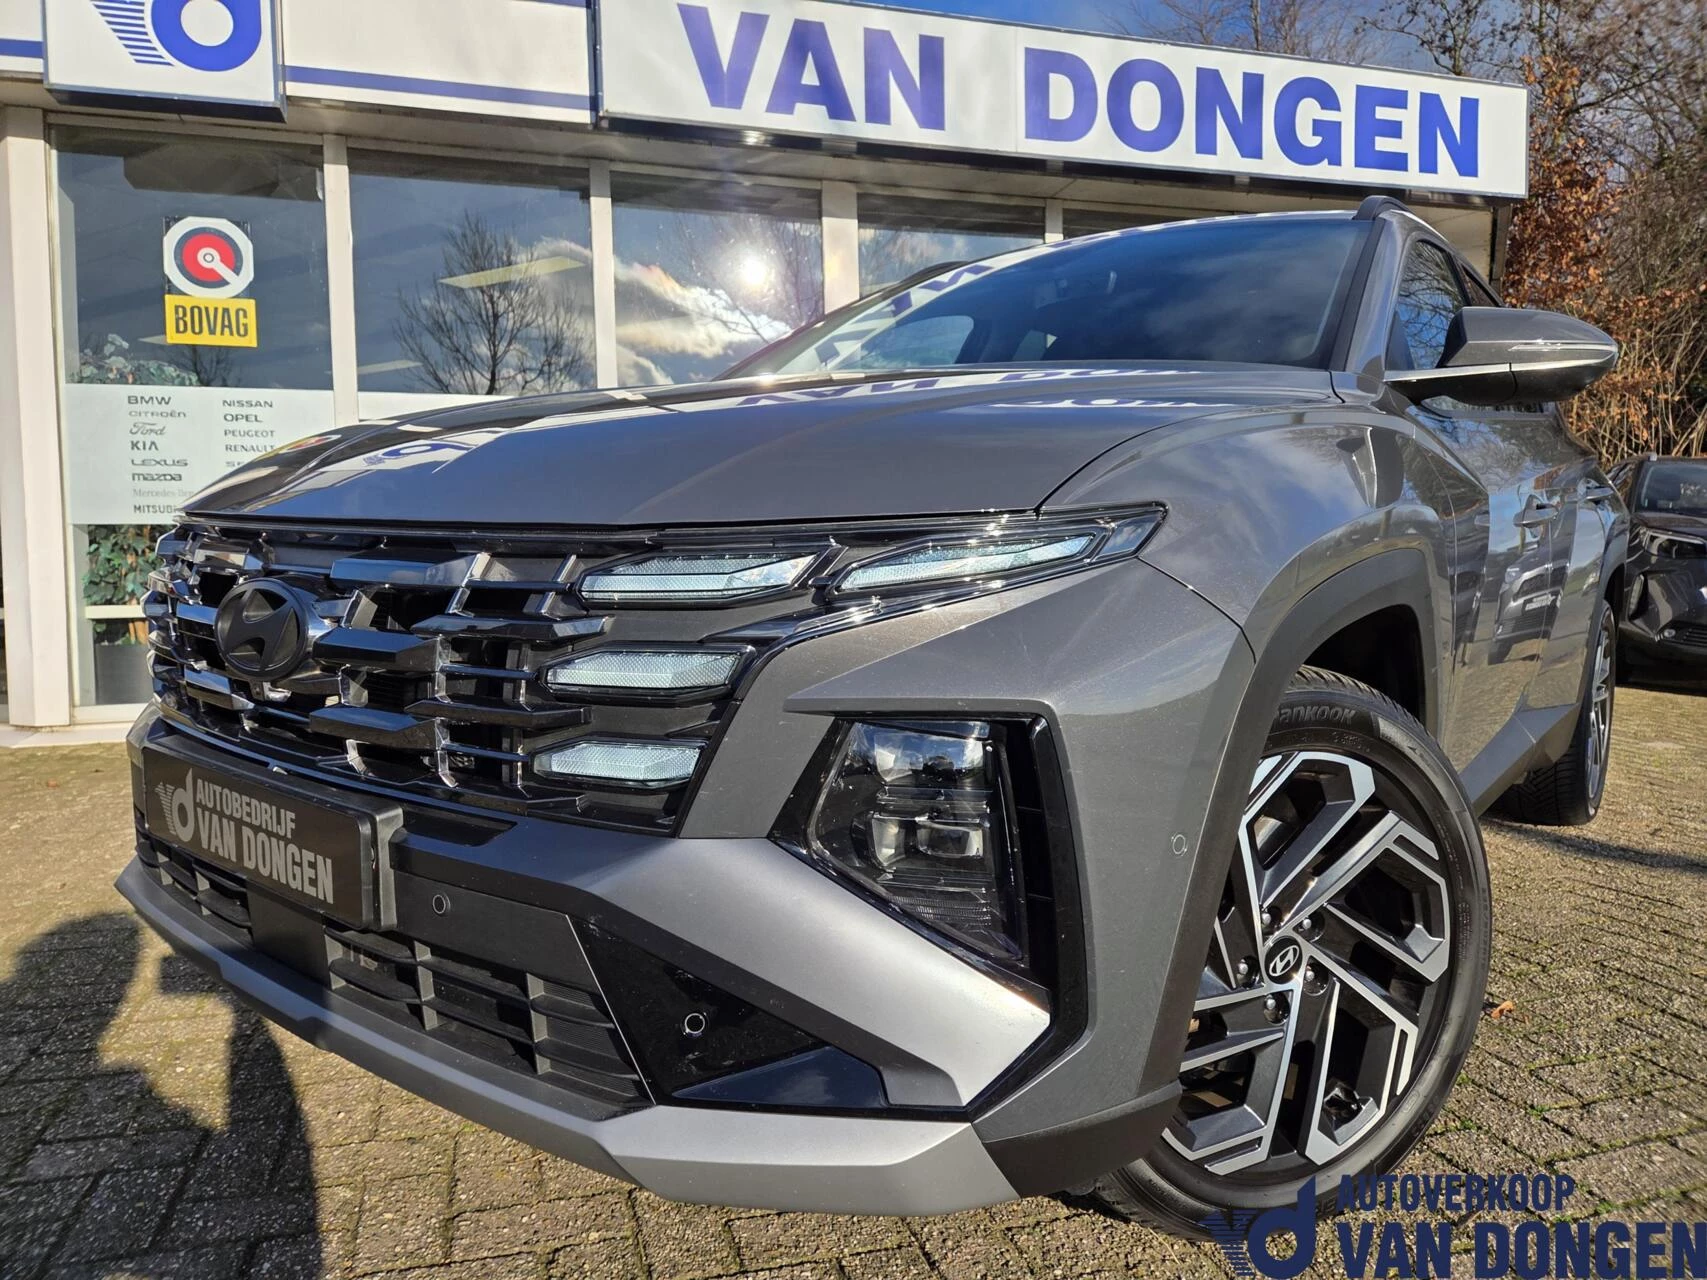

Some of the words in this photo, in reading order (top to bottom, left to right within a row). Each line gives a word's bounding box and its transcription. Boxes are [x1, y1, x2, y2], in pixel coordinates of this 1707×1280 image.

[679, 3, 945, 131] VAN
[1023, 46, 1479, 178] DONGEN
[173, 304, 249, 337] BOVAG
[128, 395, 172, 405] BMW
[222, 399, 273, 408] NISSAN
[223, 413, 264, 422] OPEL
[129, 421, 166, 436] Ford
[224, 429, 276, 438] PEUGEOT
[130, 440, 159, 451] KIA
[225, 443, 276, 453] RENAULT
[131, 458, 189, 467] LEXUS
[196, 778, 296, 839] AUTOBEDRIJF
[197, 808, 237, 863] VAN
[242, 826, 334, 905] DONGEN
